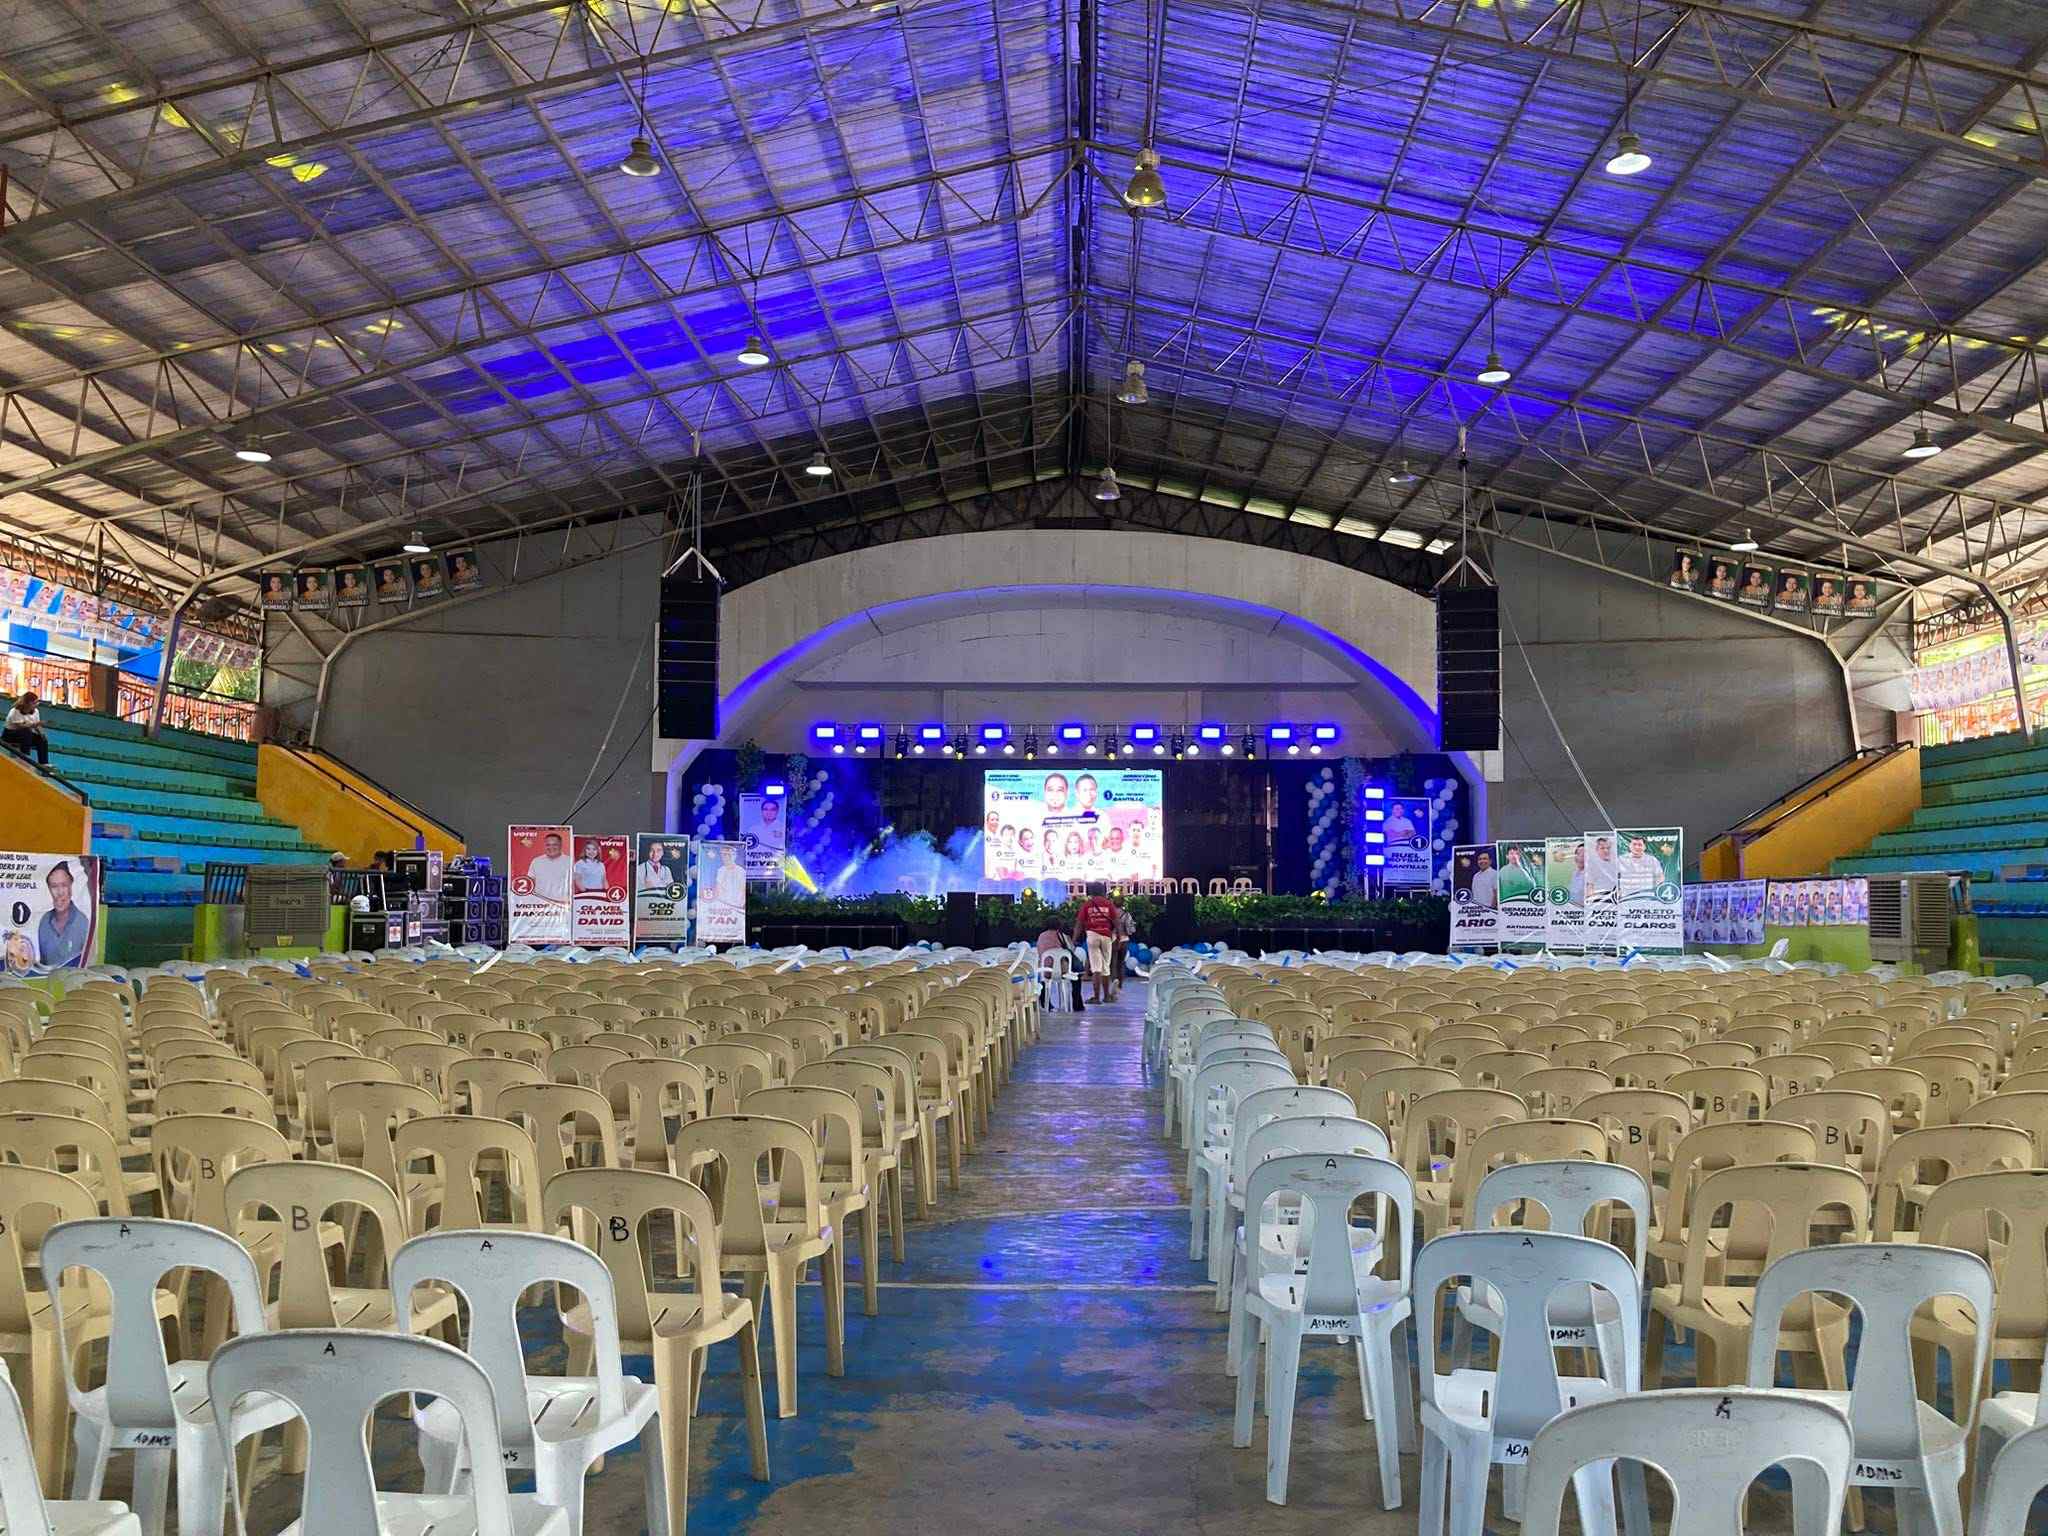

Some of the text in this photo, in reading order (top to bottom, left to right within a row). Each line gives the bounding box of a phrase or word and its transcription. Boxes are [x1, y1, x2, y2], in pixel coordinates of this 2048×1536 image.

[1415, 837, 1422, 848] 1
[517, 879, 528, 892] 2
[671, 885, 681, 898] 5
[611, 889, 621, 901] 4
[1459, 890, 1469, 902] 2
[1532, 889, 1544, 902] 4
[1554, 889, 1564, 902] 3
[1660, 889, 1674, 903] 4
[577, 918, 624, 926] DAVID
[708, 917, 738, 925] TAN
[718, 1071, 729, 1085] B
[1788, 1080, 1800, 1096] B
[1931, 1082, 1944, 1099] B
[1714, 1095, 1726, 1113] B
[1629, 1125, 1643, 1145] B
[1825, 1125, 1840, 1145] B
[200, 1158, 216, 1180] B
[291, 1205, 311, 1232] B
[119, 1223, 132, 1239] A
[479, 1239, 495, 1252] A
[323, 1340, 336, 1356] A
